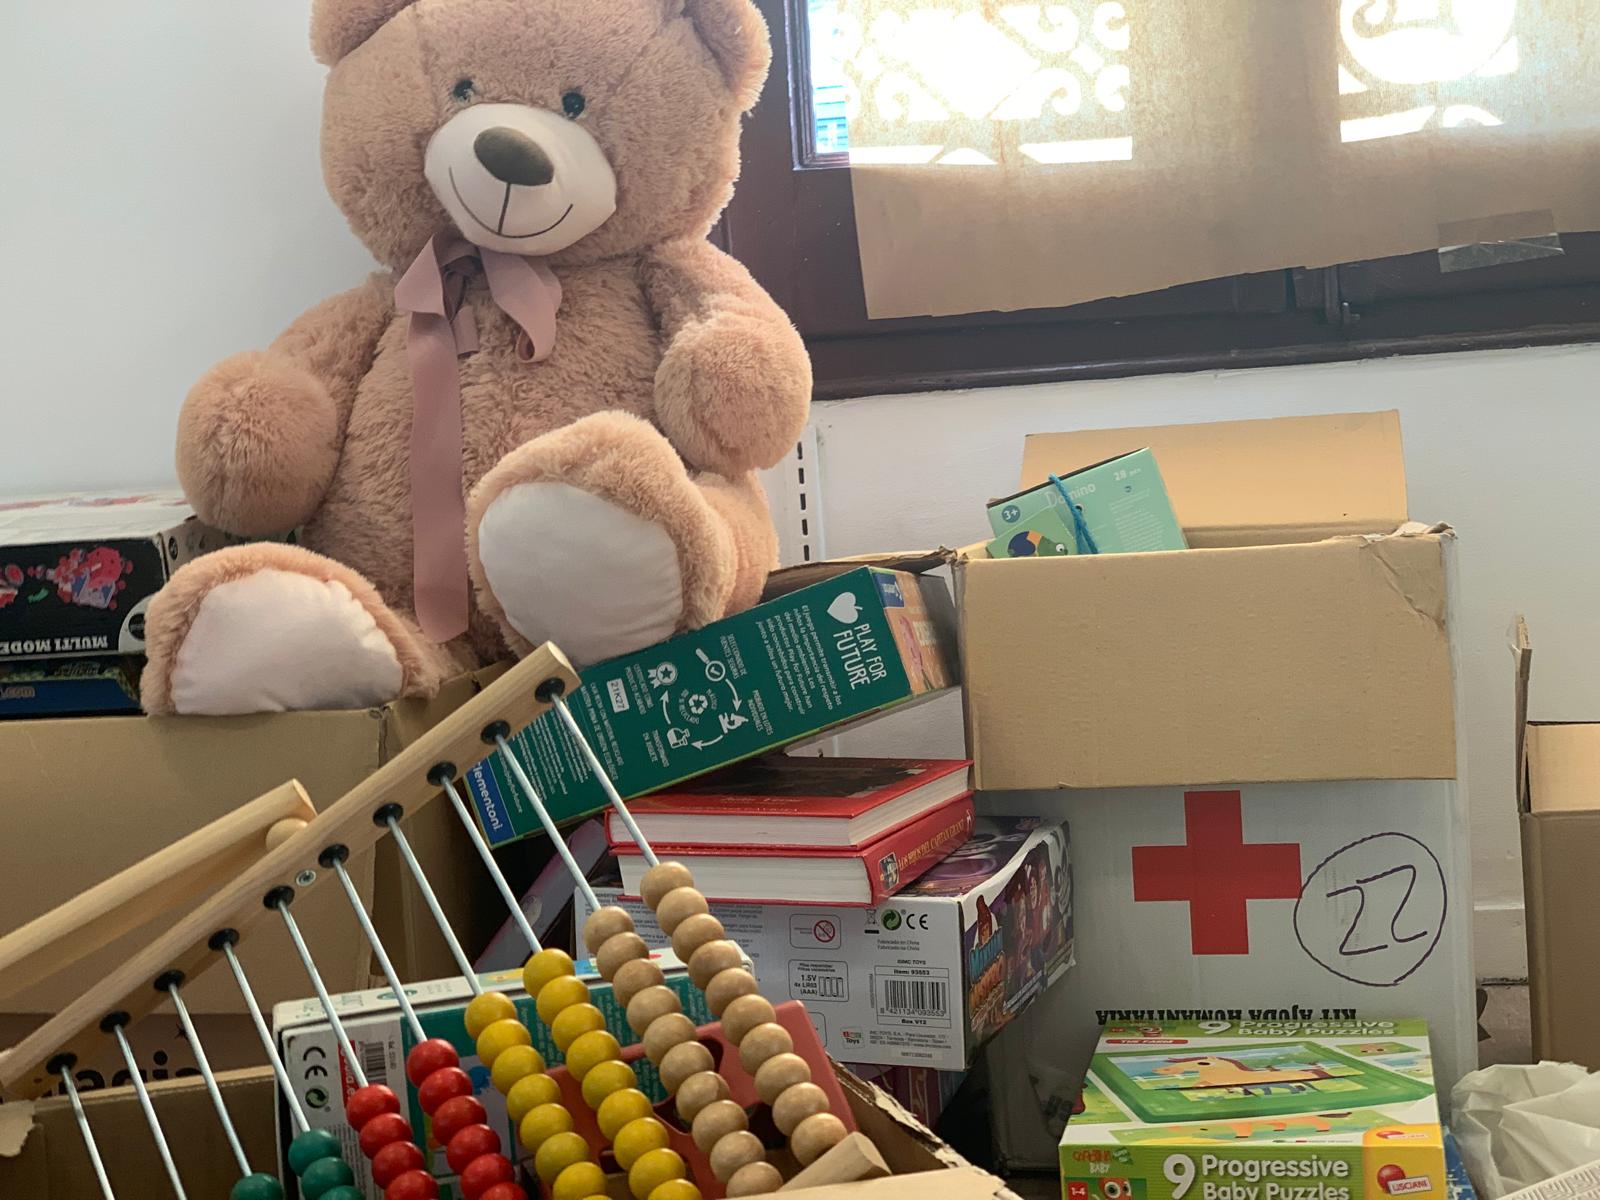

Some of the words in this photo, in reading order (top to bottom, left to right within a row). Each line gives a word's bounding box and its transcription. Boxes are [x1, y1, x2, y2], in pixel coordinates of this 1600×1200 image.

[784, 611, 792, 623] del
[755, 621, 768, 640] junto
[787, 622, 799, 644] medio
[853, 623, 878, 653] PLAY
[54, 635, 109, 650] MULTI
[765, 644, 775, 660] ellos
[802, 633, 820, 673] importancia
[766, 618, 775, 632] sido
[771, 632, 789, 670] concebidos
[783, 670, 794, 685] para
[790, 685, 805, 715] construir
[771, 660, 778, 669] un
[773, 614, 791, 648] productos
[787, 648, 796, 662] Play
[792, 662, 800, 673] for
[796, 673, 808, 695] Future
[804, 695, 813, 708] han
[802, 612, 815, 631] juego
[809, 631, 825, 658] permite
[820, 657, 837, 689] transmitir
[834, 694, 842, 705] los
[832, 629, 871, 690] FUTURE
[865, 655, 887, 681] FOR
[774, 669, 786, 690] futuro
[807, 677, 816, 689] Los
[816, 673, 825, 684] del
[610, 681, 626, 709] 21K27
[820, 684, 833, 710] respeto
[471, 763, 503, 830] lementoni
[1199, 1020, 1232, 1035] 9
[1239, 1020, 1395, 1030] Progressive
[1237, 1027, 1299, 1037] Baby
[1304, 1027, 1395, 1036] Puzzles
[1088, 1162, 1110, 1173] BABY
[1163, 1154, 1195, 1200] 9
[1201, 1155, 1349, 1182] Progressive
[1201, 1182, 1264, 1200] Baby
[1268, 1182, 1349, 1200] Puzzles
